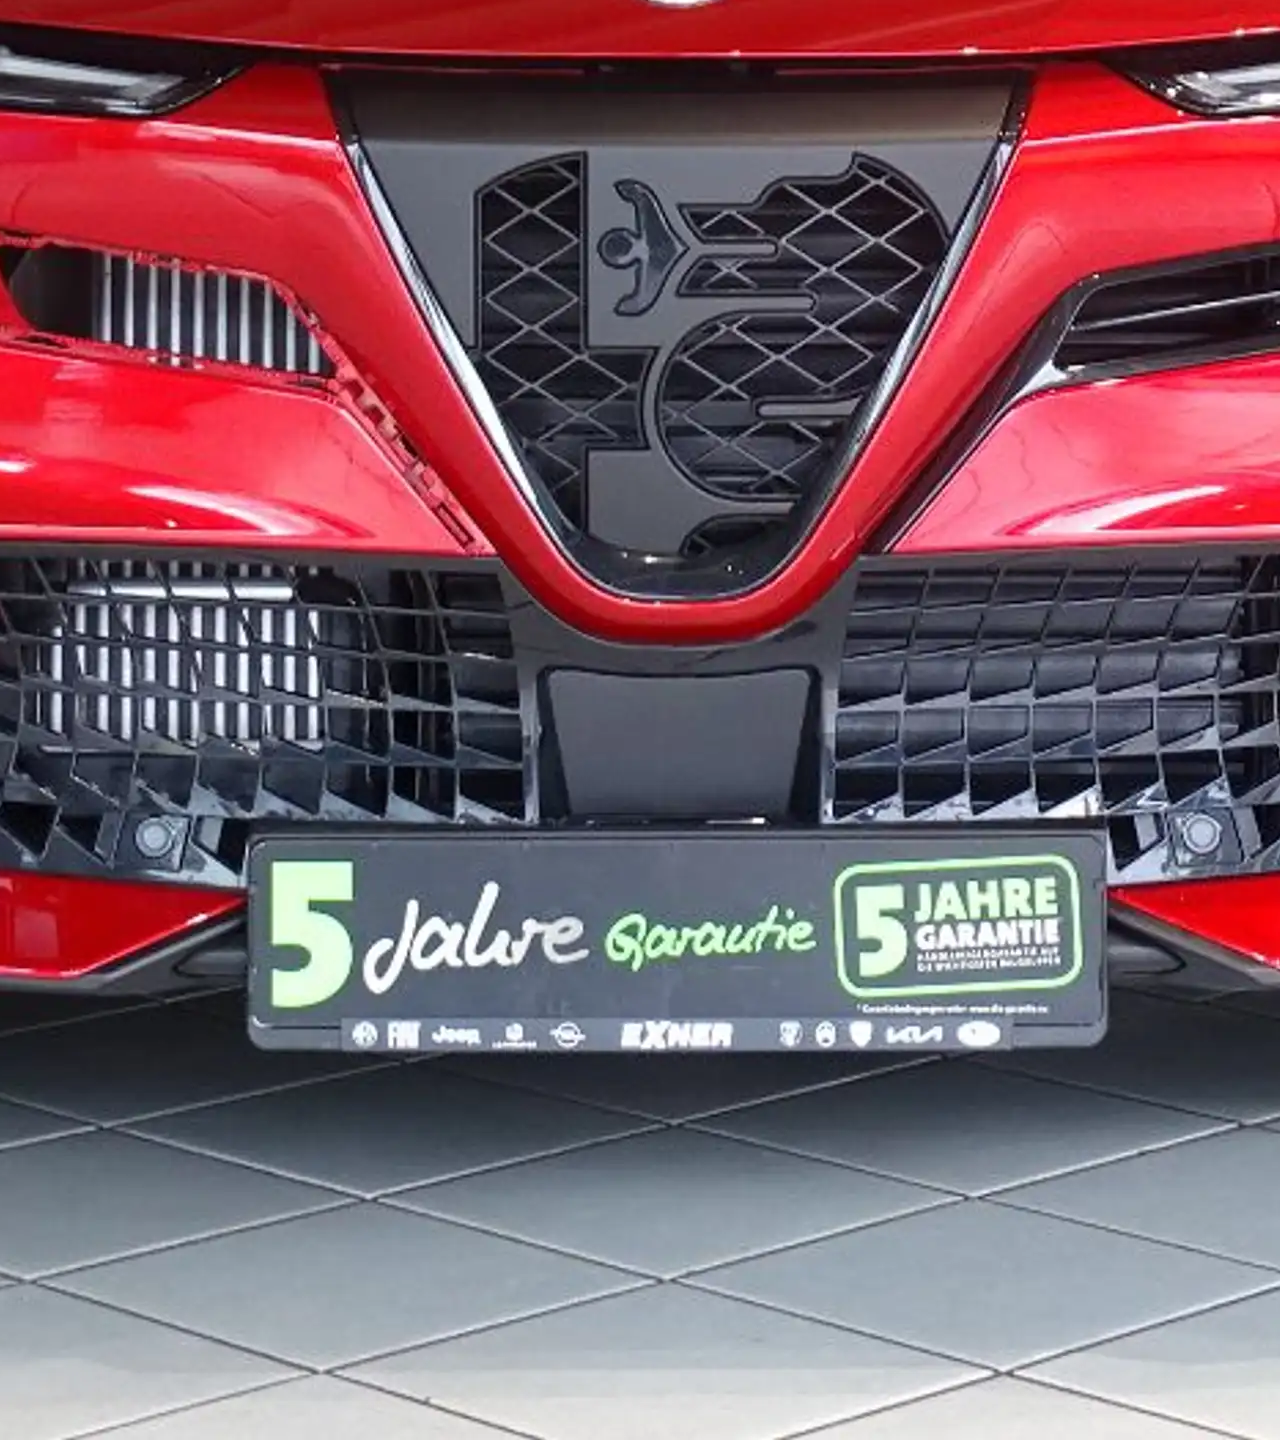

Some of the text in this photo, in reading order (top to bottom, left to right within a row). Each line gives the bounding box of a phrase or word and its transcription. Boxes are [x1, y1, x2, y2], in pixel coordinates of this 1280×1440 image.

[270, 860, 817, 1007] 5 Jahre Garantie
[856, 876, 1058, 977] 5 JAHRE
[915, 918, 1060, 949] GARANTIE
[621, 1020, 733, 1050] EXNER
